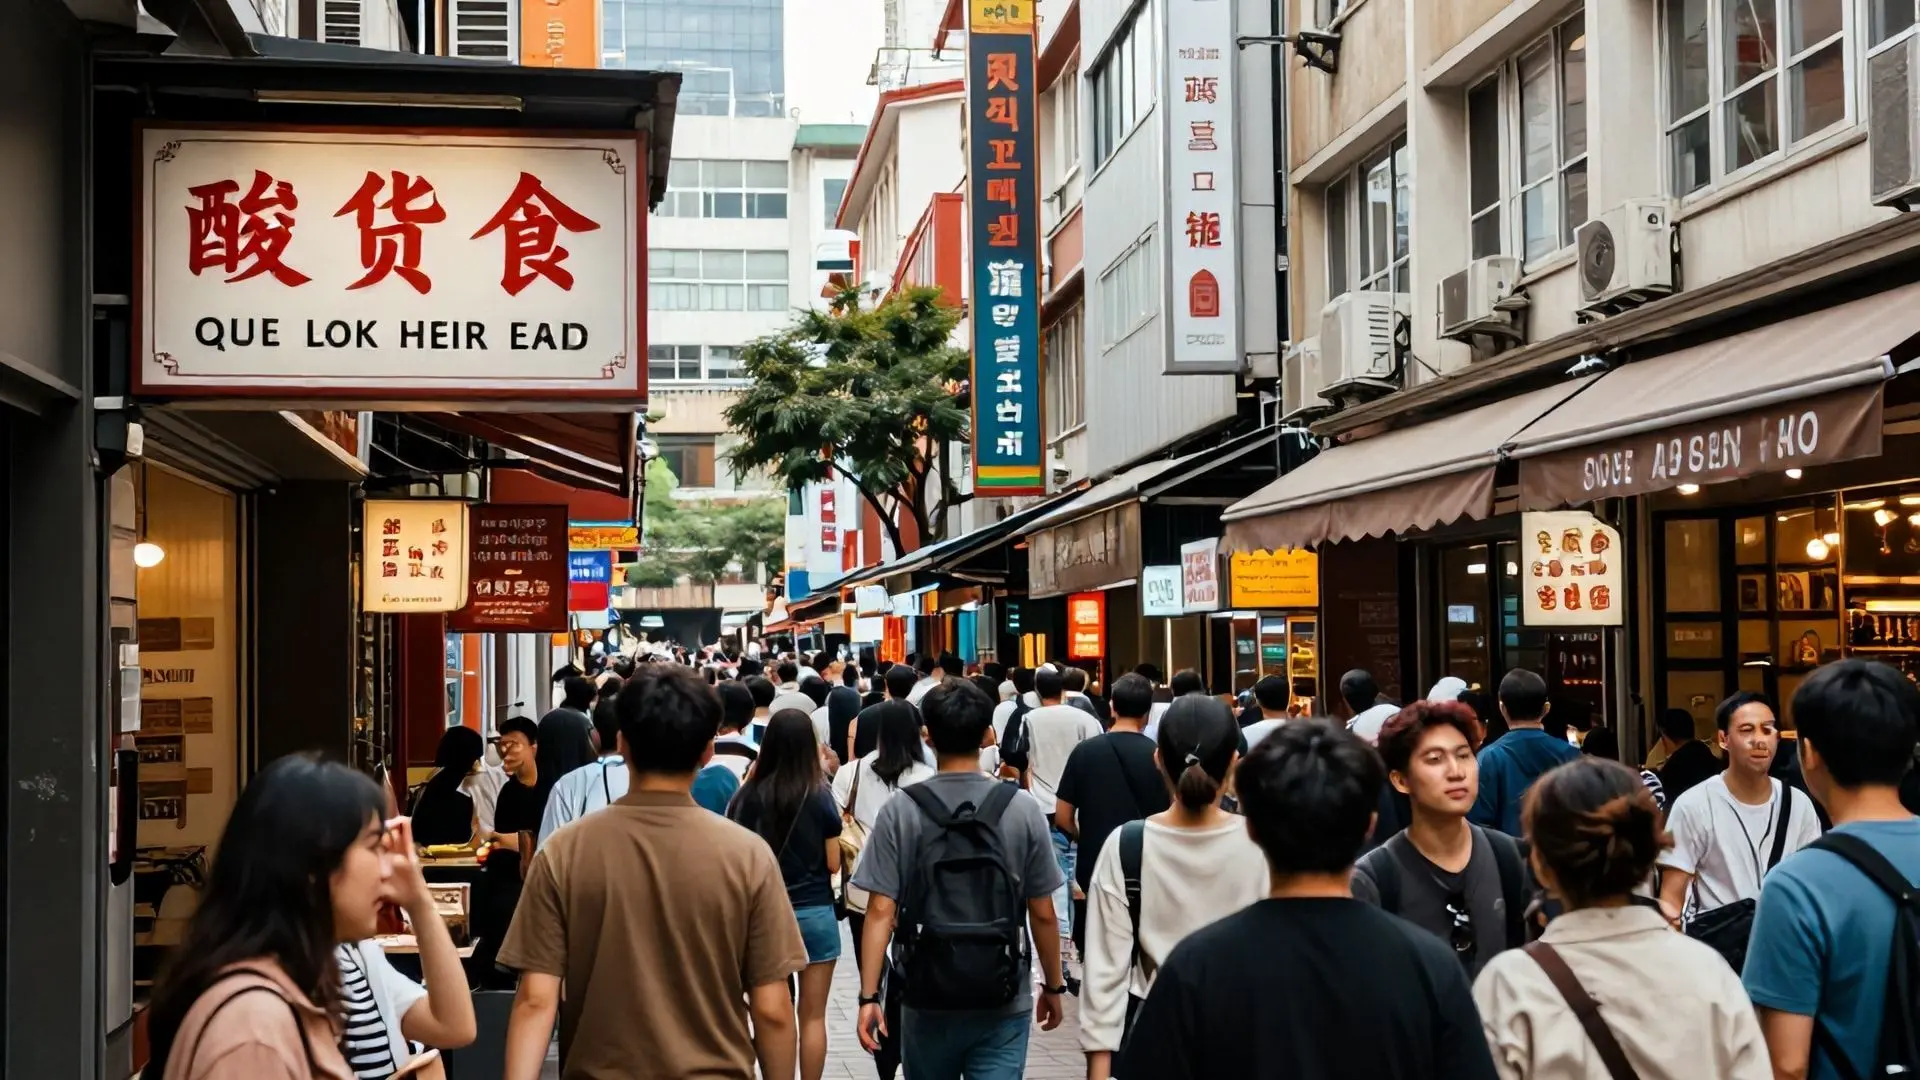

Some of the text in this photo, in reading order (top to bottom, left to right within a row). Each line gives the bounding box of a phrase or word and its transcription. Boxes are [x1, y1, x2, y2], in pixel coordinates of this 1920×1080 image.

[194, 316, 589, 352] QUE LOK HEIR EAD
